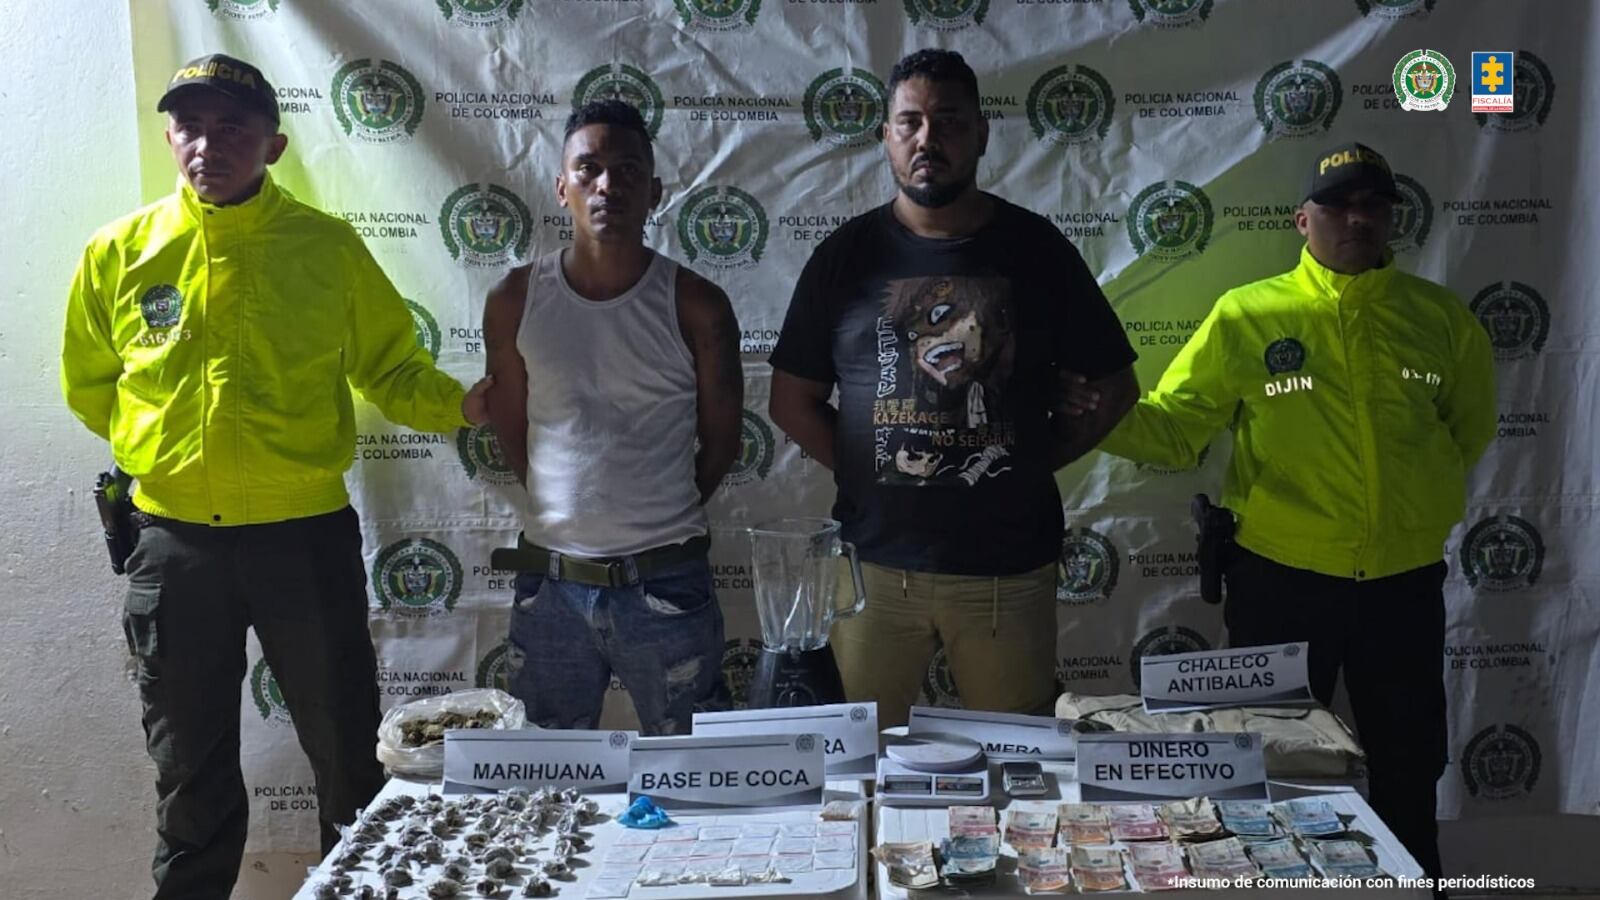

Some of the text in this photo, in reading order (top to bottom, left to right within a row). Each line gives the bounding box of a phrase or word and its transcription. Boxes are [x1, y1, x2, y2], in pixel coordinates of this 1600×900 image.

[171, 61, 257, 89] POLICIA
[277, 87, 323, 99] CIONAL
[435, 92, 559, 105] POLICIA NACIONAL
[1125, 91, 1241, 104] POLICIA NACIONAL
[674, 96, 792, 107] POLICIA NACIONAL
[1364, 98, 1379, 110] DE
[452, 107, 543, 119] DE COLOMBIA
[690, 110, 778, 121] DE COLOMBIA
[1139, 106, 1225, 118] DE COLOMBIA
[1443, 198, 1553, 212] POLICIA NACIONAL
[1055, 212, 1119, 223] NACIONAL
[1223, 206, 1271, 217] POLICIA
[370, 212, 431, 224] NACIONAL
[543, 216, 572, 226] POLI
[779, 216, 828, 227] POLICIA
[1458, 213, 1538, 226] DE COLOMBIA
[1238, 220, 1256, 231] DE
[558, 230, 573, 240] DE
[794, 230, 812, 241] DE
[1064, 227, 1104, 237] OMBIA
[1126, 320, 1173, 332] POLICIA
[1140, 335, 1157, 345] DE
[465, 342, 480, 353] DE
[1264, 376, 1313, 396] DIJIN
[873, 411, 949, 425] KAZEKAGE
[1498, 413, 1550, 424] ACIONAL
[381, 433, 447, 446] NACIONAL
[931, 434, 955, 447] NO
[362, 448, 433, 460] COLOMBIA
[1128, 553, 1175, 564] POLICIA
[1142, 566, 1159, 577] DE
[488, 579, 505, 590] DE
[713, 578, 729, 589] DE
[1445, 643, 1546, 656] OLICIA NACIONAL
[1063, 656, 1123, 668] NACIONAL
[1178, 654, 1269, 673] CHALECO
[1451, 656, 1530, 670] DE COLOMBIA
[403, 671, 467, 682] NACIONAL
[1055, 669, 1110, 680] OLOMBIA
[1168, 671, 1275, 693] ANTIBALAS
[387, 686, 452, 696] COLOMBIA
[1128, 742, 1209, 758] DINERO
[473, 763, 605, 780] MARIHUANA
[1095, 763, 1234, 780] EN EFECTIVO
[641, 769, 810, 790] BASE DE COCA
[255, 787, 304, 798] POLICIA
[270, 800, 288, 811] DE
